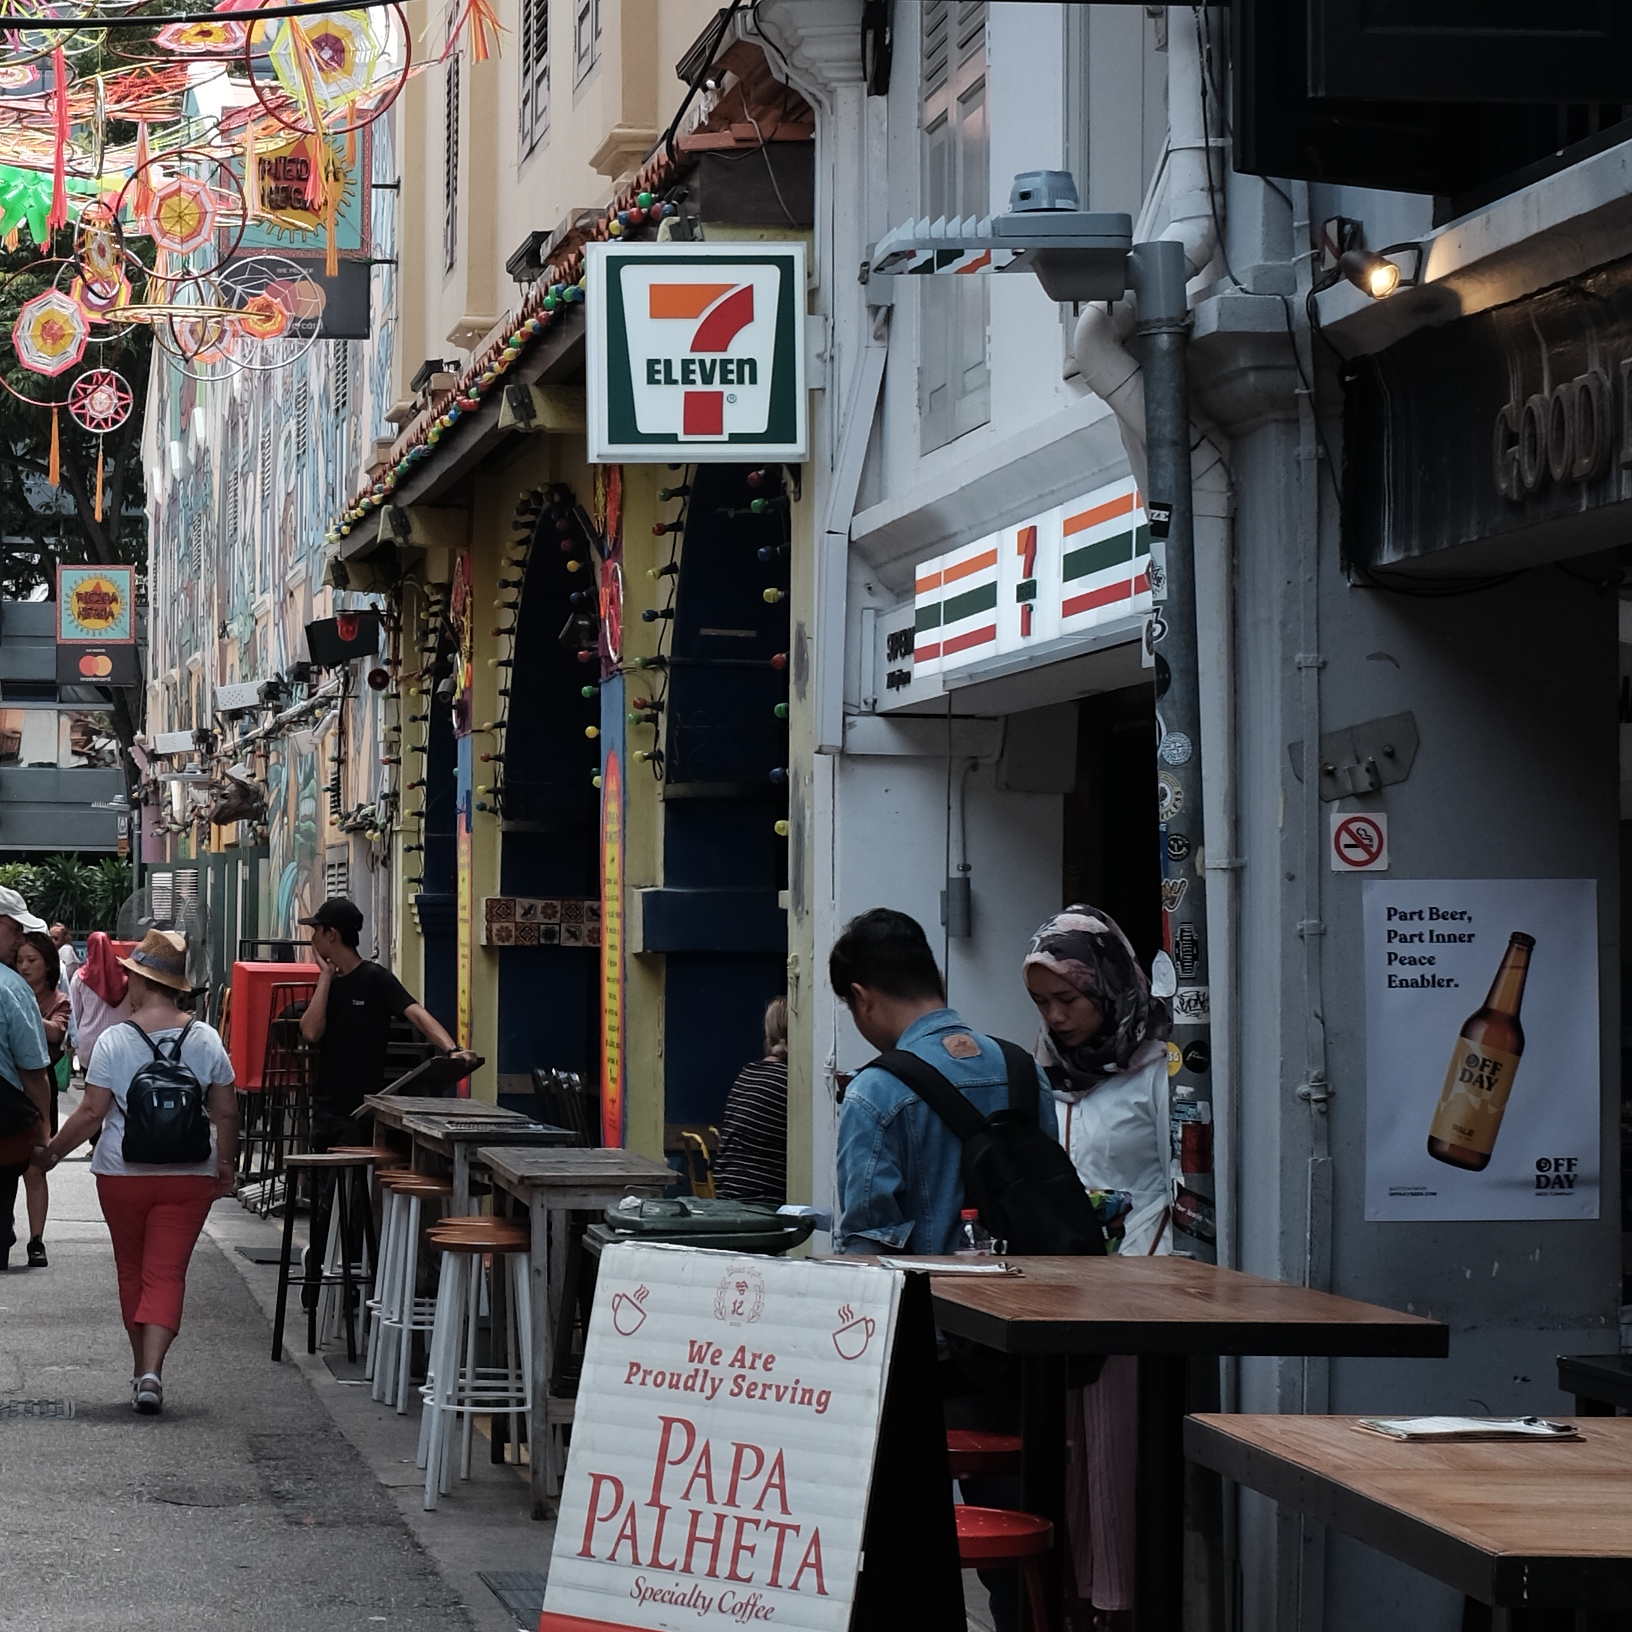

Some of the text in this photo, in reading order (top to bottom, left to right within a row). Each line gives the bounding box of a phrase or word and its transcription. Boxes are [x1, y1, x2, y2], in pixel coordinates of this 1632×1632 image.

[1491, 368, 1614, 502] GOOD
[1386, 906, 1473, 924] Part Beer,
[1386, 929, 1476, 944] Part Inner
[1386, 951, 1437, 967] Peace
[1387, 973, 1460, 989] Enabler.
[1465, 1053, 1504, 1076] OFF
[1458, 1068, 1499, 1093] DAY
[1535, 1156, 1579, 1174] OFF
[1534, 1173, 1578, 1190] DAY
[687, 1340, 776, 1372] We Are
[623, 1360, 832, 1415] Proudly Serving
[644, 1414, 793, 1517] PAPA
[575, 1471, 830, 1597] PALHETA
[629, 1574, 776, 1625] Specialty Coffee
